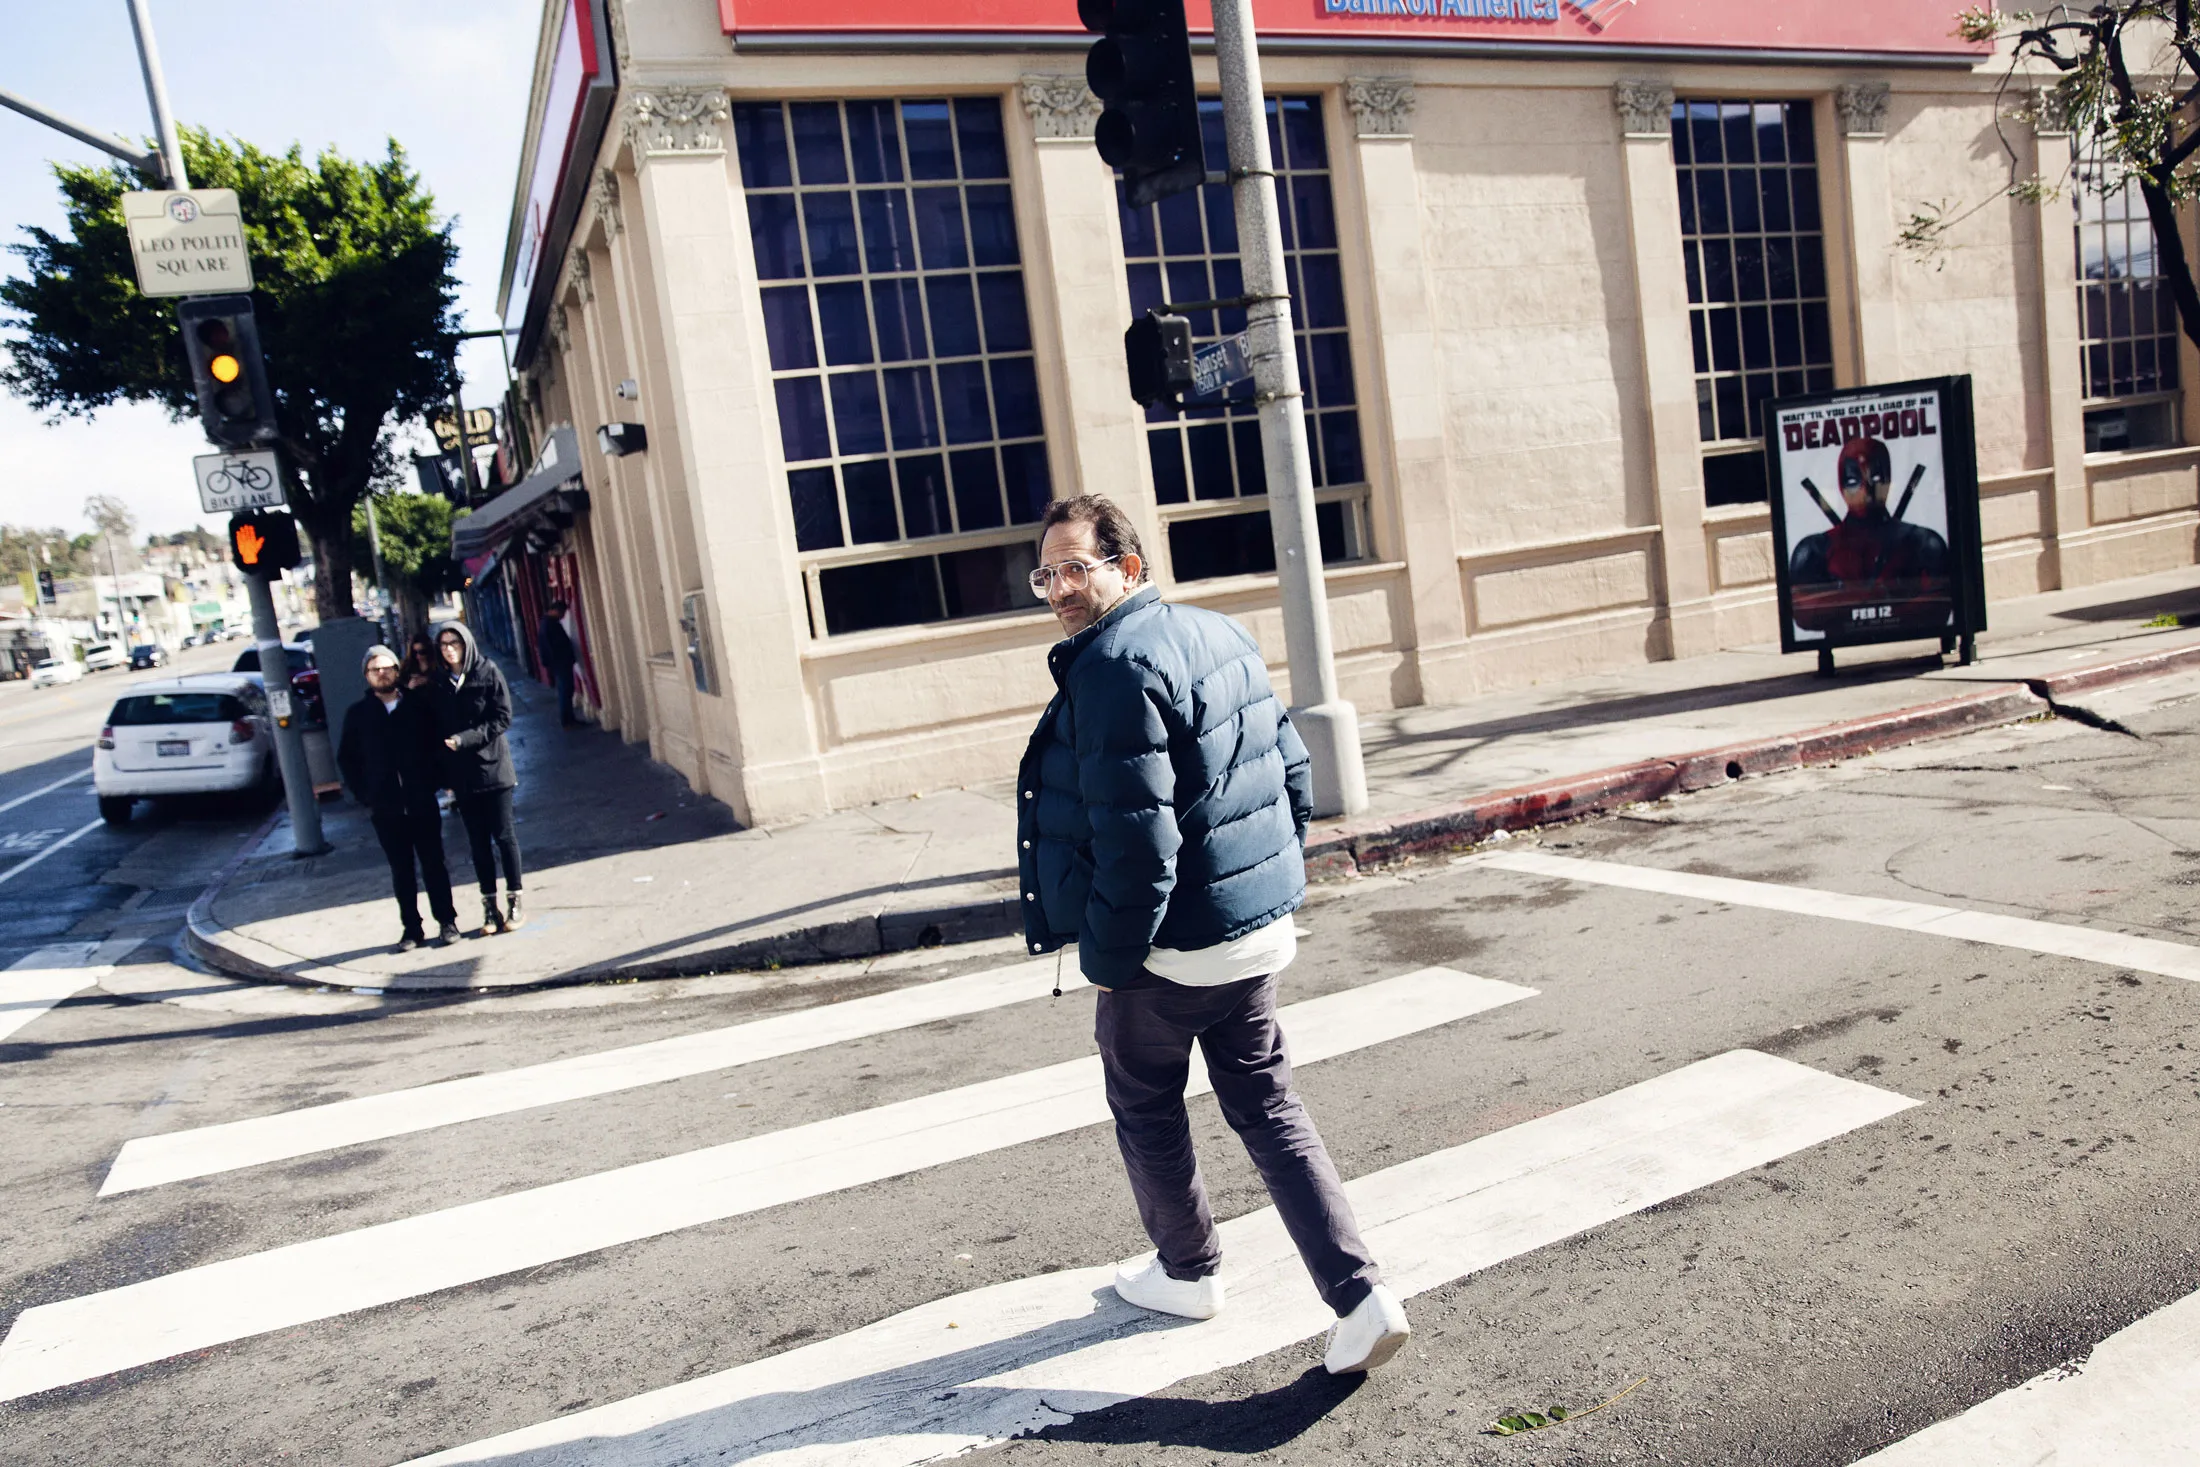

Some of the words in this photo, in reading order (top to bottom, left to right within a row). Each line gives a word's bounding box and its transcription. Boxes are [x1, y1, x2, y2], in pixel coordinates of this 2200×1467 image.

[1440, 0, 1560, 20] America
[140, 237, 175, 253] LEO
[181, 235, 240, 251] POLITI
[156, 257, 230, 277] SQUARE
[1194, 344, 1229, 378] Sunset
[1782, 413, 1805, 423] WAIT
[1826, 408, 1846, 418] YOU
[1848, 405, 1866, 415] GET
[1869, 404, 1875, 412] A
[1878, 400, 1903, 412] LOAD
[1905, 398, 1917, 408] OF
[1920, 396, 1934, 406] ME
[1783, 407, 1937, 452] DEADPOOL
[210, 496, 237, 509] BIKE
[241, 492, 273, 508] LANE
[1852, 606, 1876, 621] FEB
[1878, 605, 1892, 619] 12
